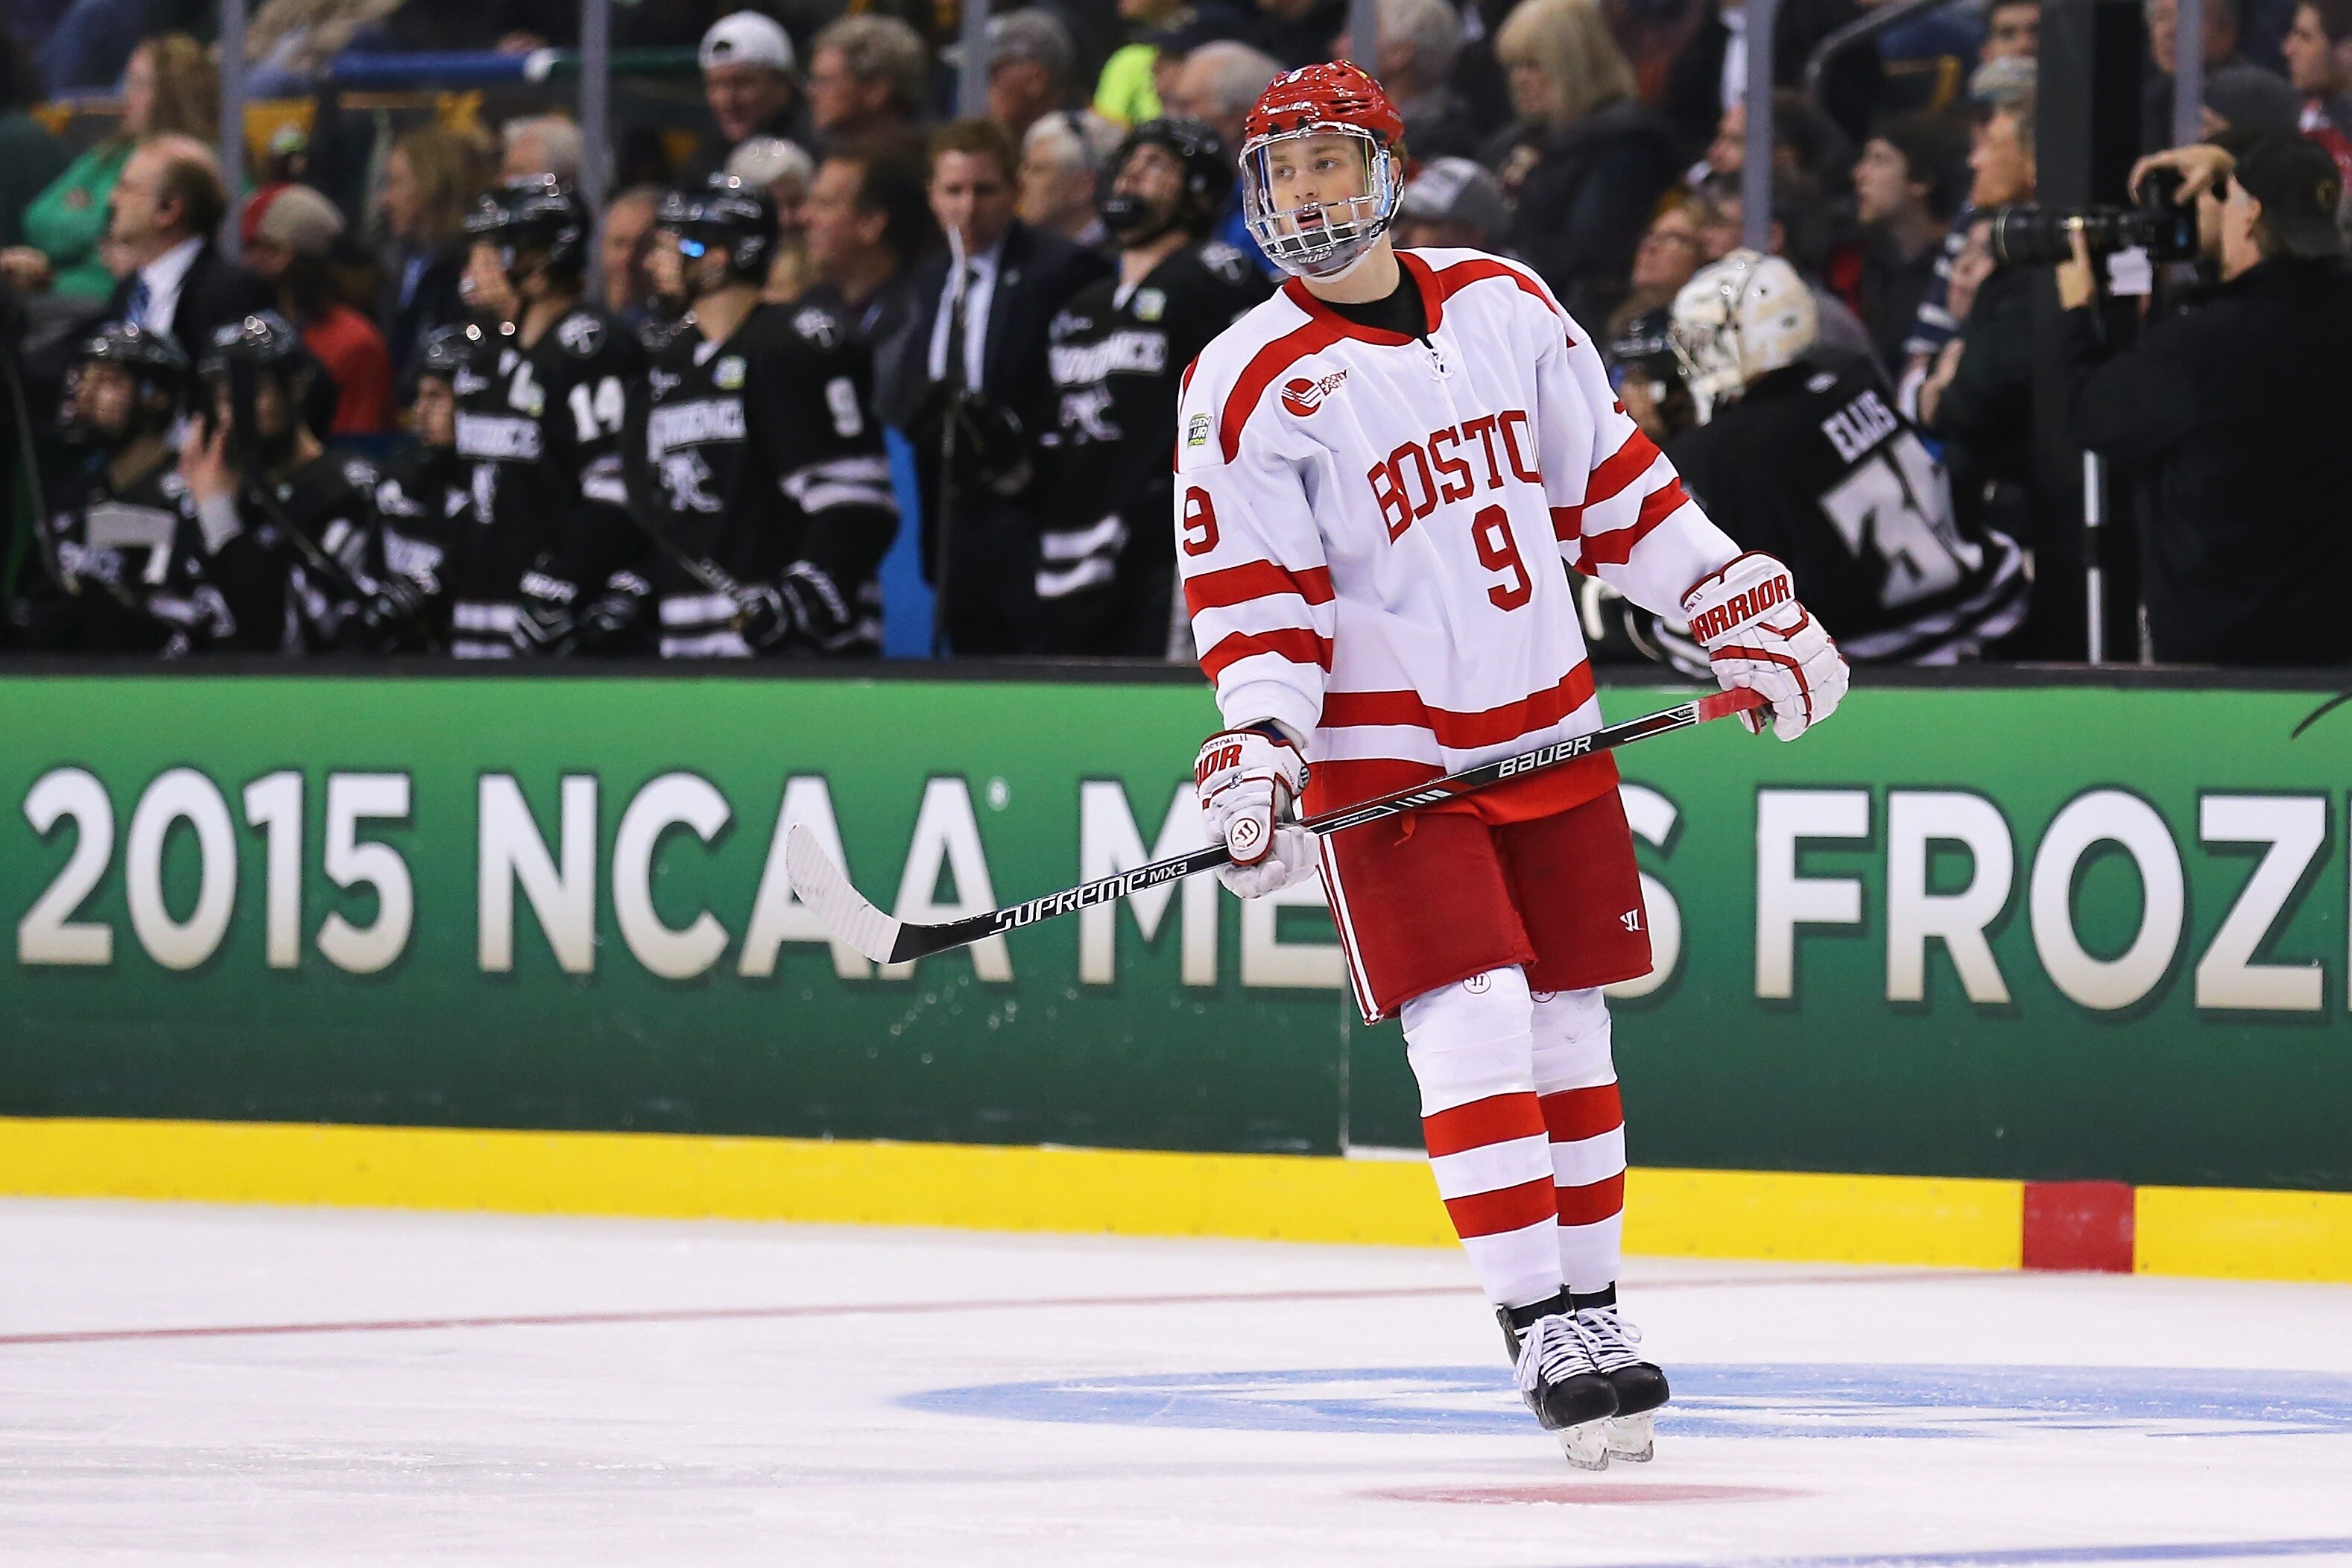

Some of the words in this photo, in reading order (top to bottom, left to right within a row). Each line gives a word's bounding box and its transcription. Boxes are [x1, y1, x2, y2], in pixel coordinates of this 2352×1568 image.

[1182, 487, 1220, 557] 9
[1367, 410, 1543, 546] BOSTO
[1471, 504, 1532, 612] 9
[1498, 736, 1591, 778] BAUER
[17, 766, 414, 973] 2015
[477, 771, 1015, 982] NCAA
[1754, 789, 2352, 1012] FROZ
[990, 873, 1148, 935] SUPREME
[1148, 861, 1188, 885] MX3
